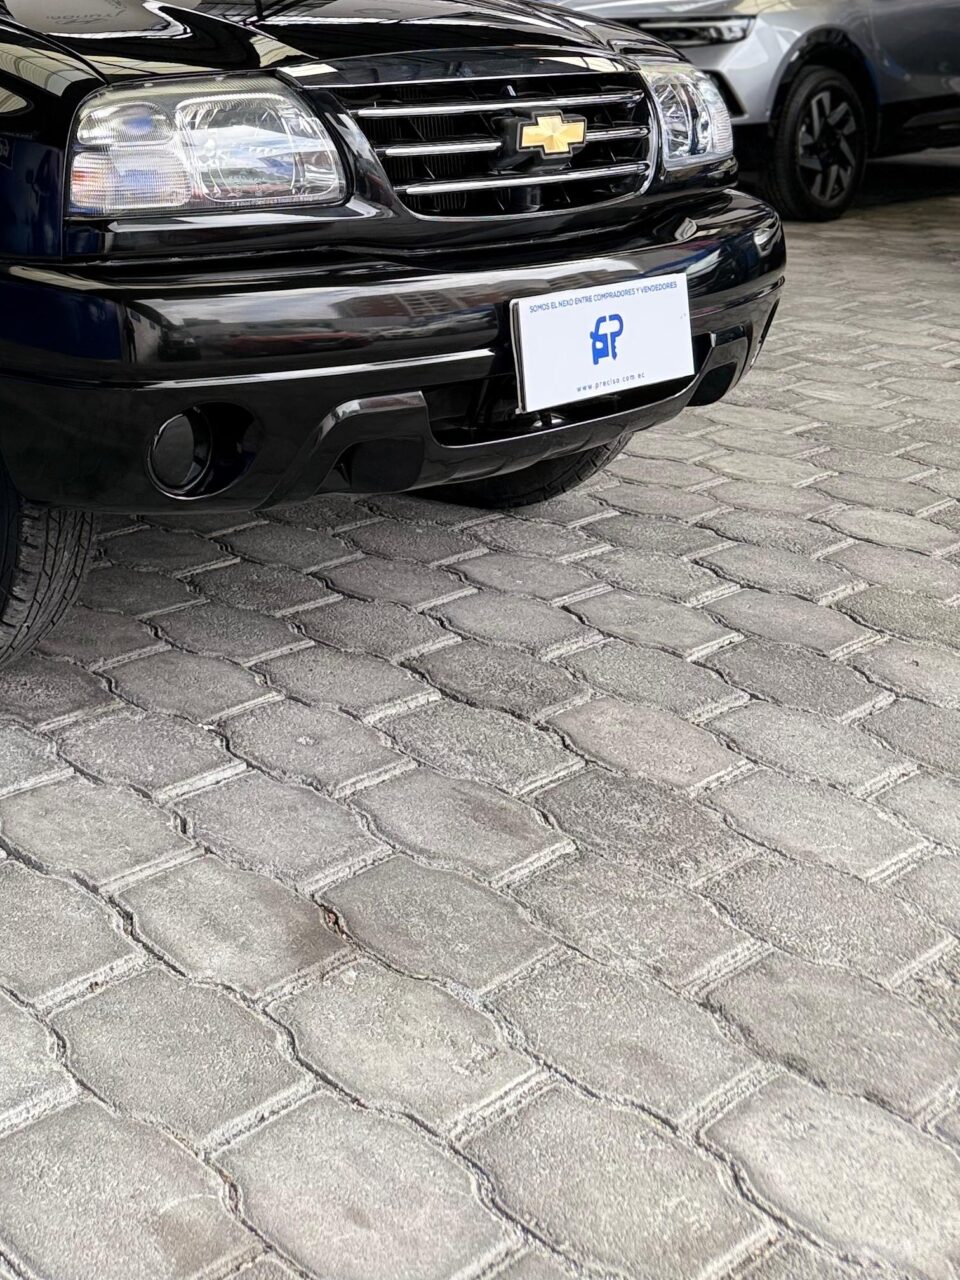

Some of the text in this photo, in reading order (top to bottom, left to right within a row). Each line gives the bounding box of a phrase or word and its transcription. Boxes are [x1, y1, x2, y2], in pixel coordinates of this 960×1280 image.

[529, 303, 550, 313] SOMOS
[551, 301, 558, 310] EL
[558, 298, 574, 308] NEXO
[575, 294, 593, 305] ENTRE
[593, 287, 636, 302] COMPRADORES
[640, 281, 678, 294] VENDEDORES
